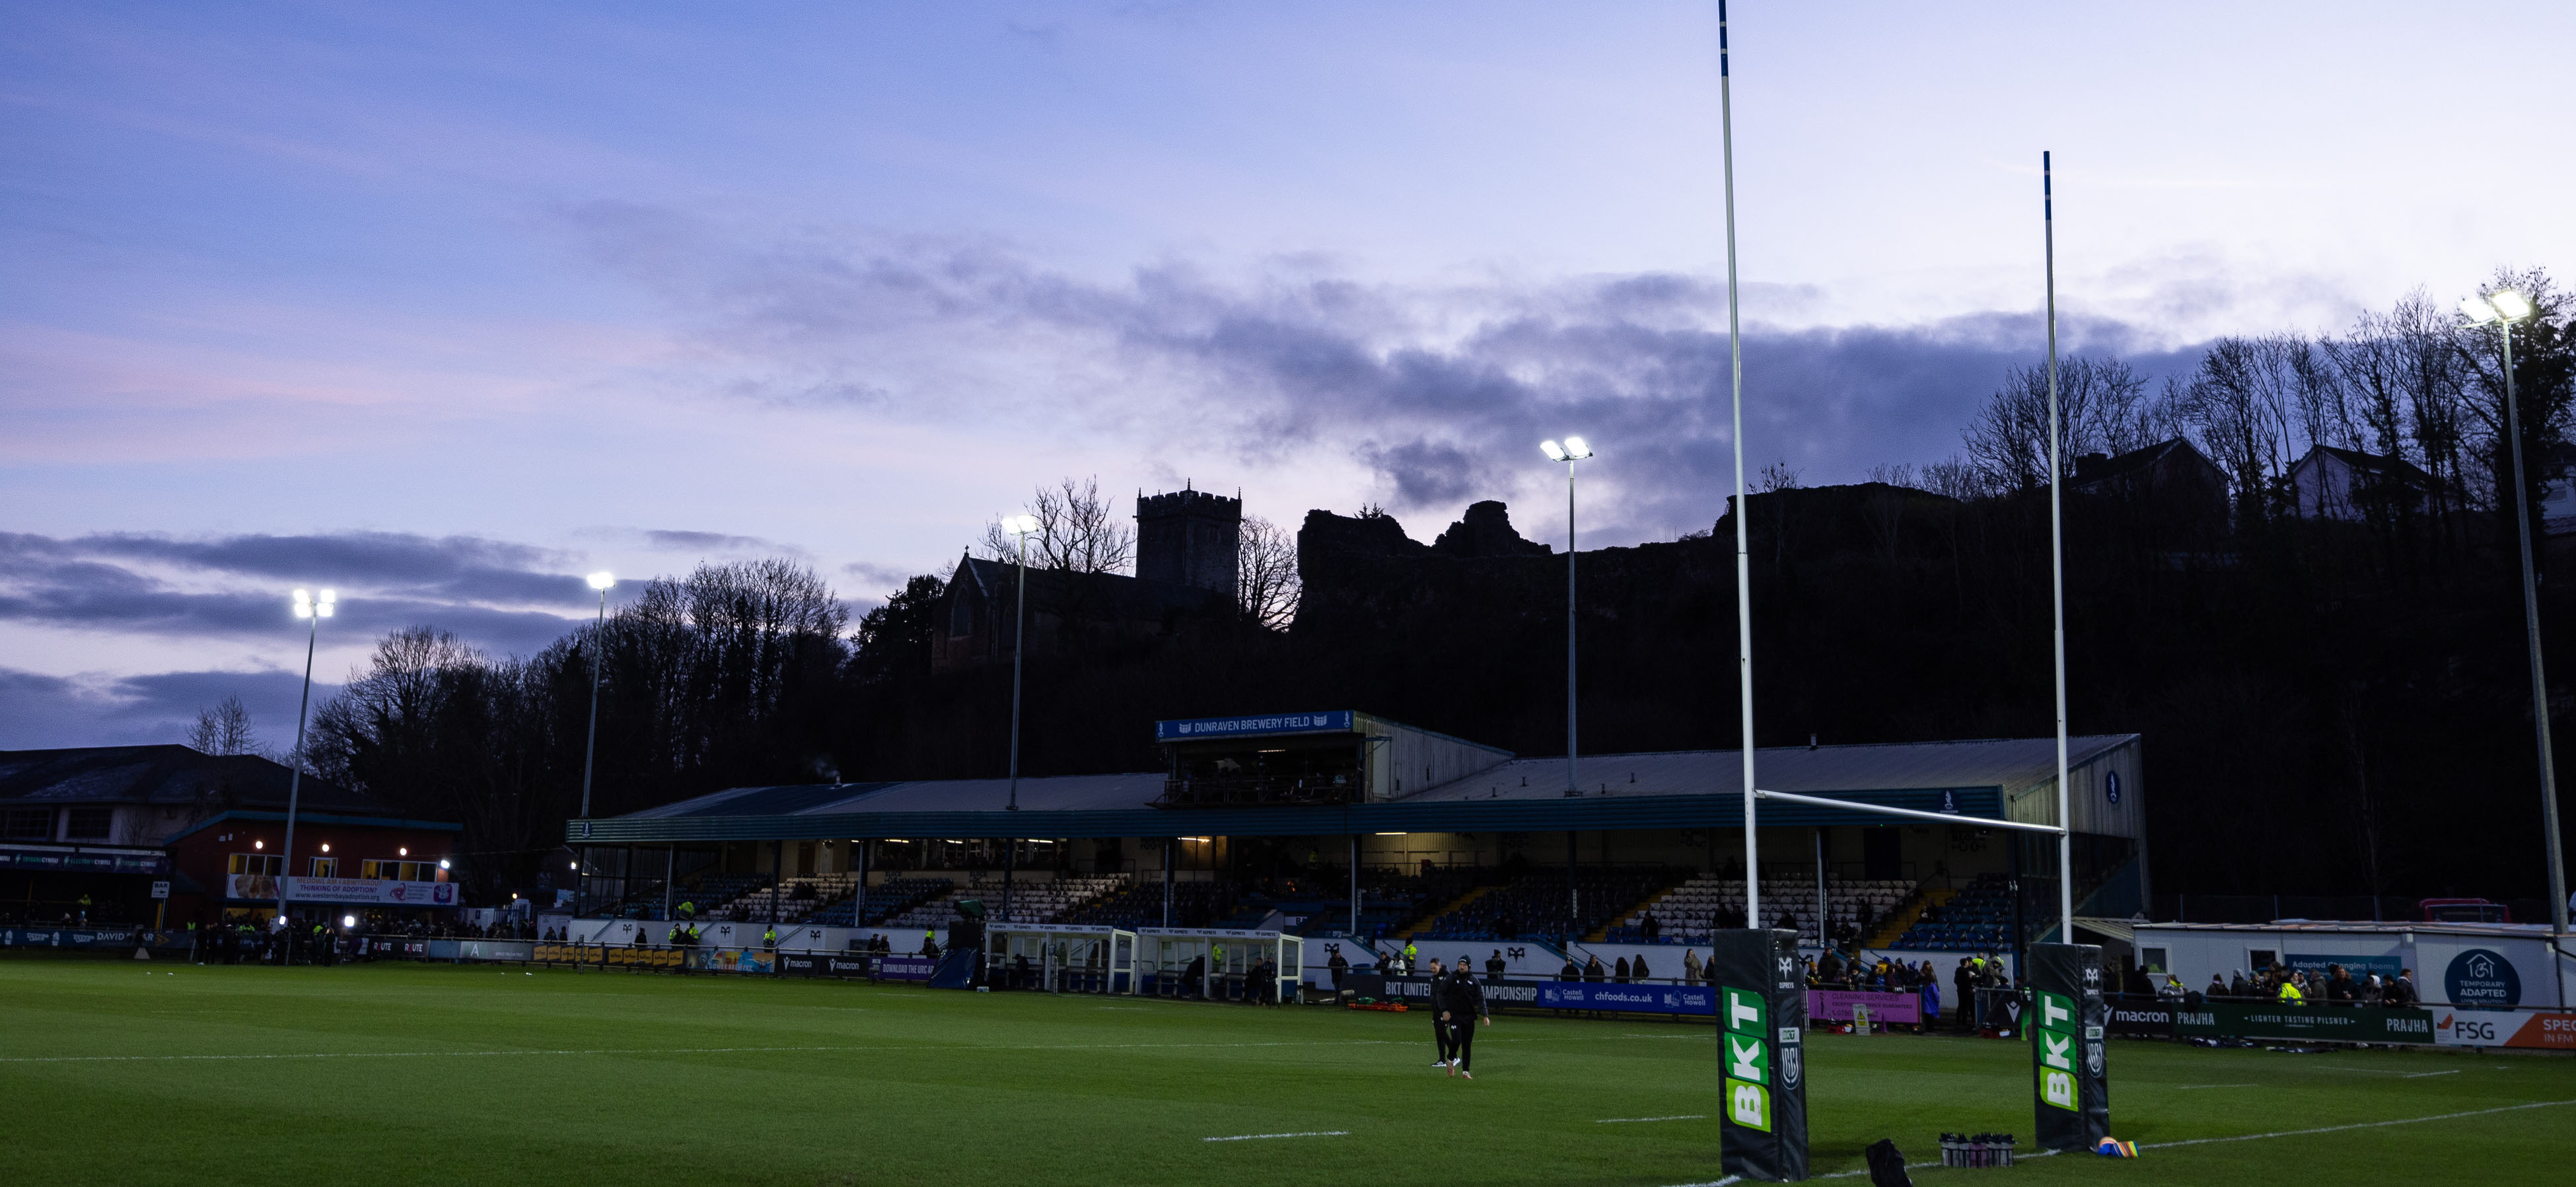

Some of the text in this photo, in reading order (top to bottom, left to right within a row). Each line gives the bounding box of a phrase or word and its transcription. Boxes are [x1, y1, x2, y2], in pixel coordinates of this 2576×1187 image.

[1194, 716, 1310, 733] DUNRAVEN BREWERY FIELD
[295, 892, 380, 901] www.westernbayadoption.org
[790, 960, 812, 968] macron
[836, 962, 859, 970] macron
[882, 964, 908, 973] DOWNLOAD
[908, 964, 917, 974] THE
[2292, 961, 2326, 970] Adapted
[1386, 982, 1403, 996] BKT
[1404, 982, 1431, 997] UNITE
[2460, 988, 2507, 997] ADAPTED
[1594, 991, 1653, 1003] chfoods.co.uk
[2116, 1011, 2170, 1023] macron
[2177, 1012, 2215, 1026] PRAVHA
[2250, 1015, 2281, 1023] LIGHTER
[2285, 1015, 2315, 1024] TASTING
[2386, 1018, 2429, 1033] PRAVHA
[2454, 1022, 2495, 1040] FSG
[2544, 1033, 2573, 1043] IN FM
[2044, 995, 2071, 1107] BKT
[1731, 992, 1762, 1127] BKT
